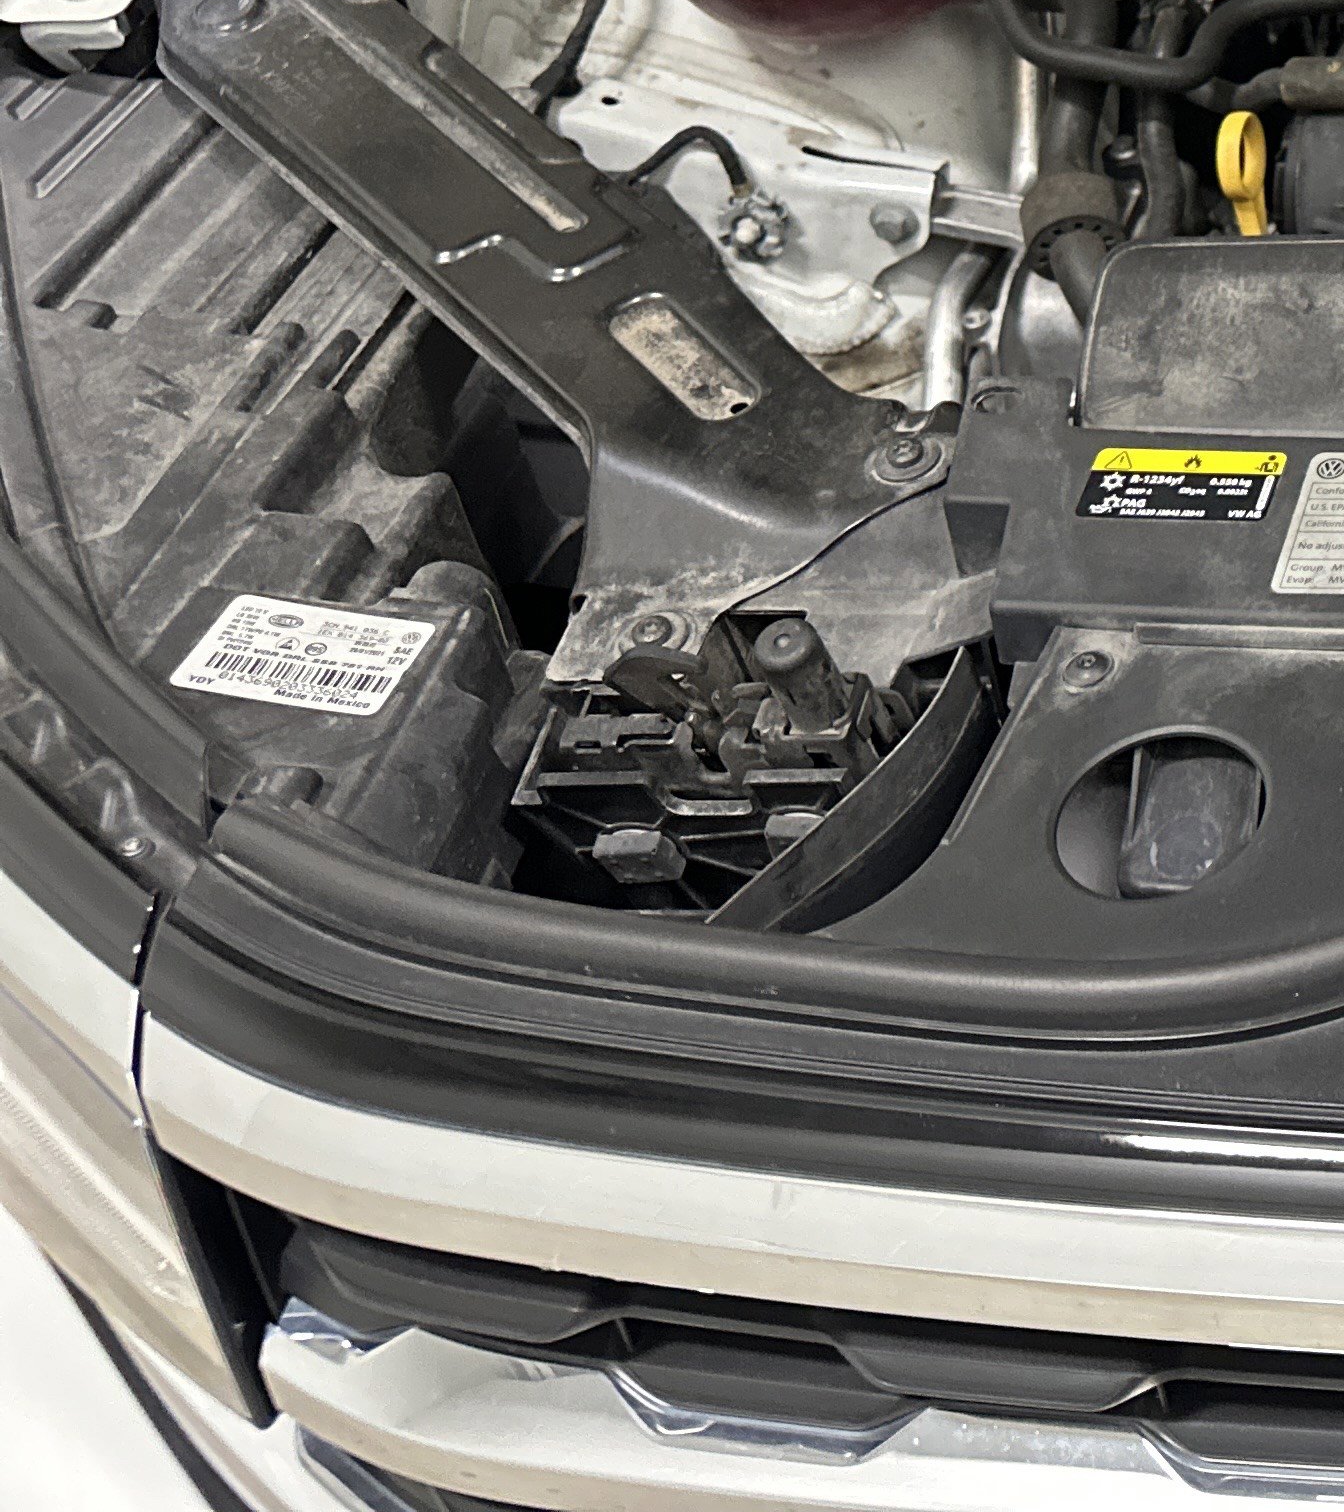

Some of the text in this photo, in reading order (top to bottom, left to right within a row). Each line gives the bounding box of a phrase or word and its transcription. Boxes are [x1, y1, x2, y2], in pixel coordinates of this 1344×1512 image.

[1129, 475, 1185, 486] R-1234yf
[1121, 498, 1147, 508] PAG
[1227, 509, 1262, 518] VW AG
[1298, 542, 1313, 550] No
[1290, 565, 1326, 573] Group:
[224, 644, 250, 652] DOT
[393, 647, 414, 656] SAE
[387, 656, 407, 665] 12V
[274, 689, 307, 700] Made
[327, 697, 370, 709] Mexico
